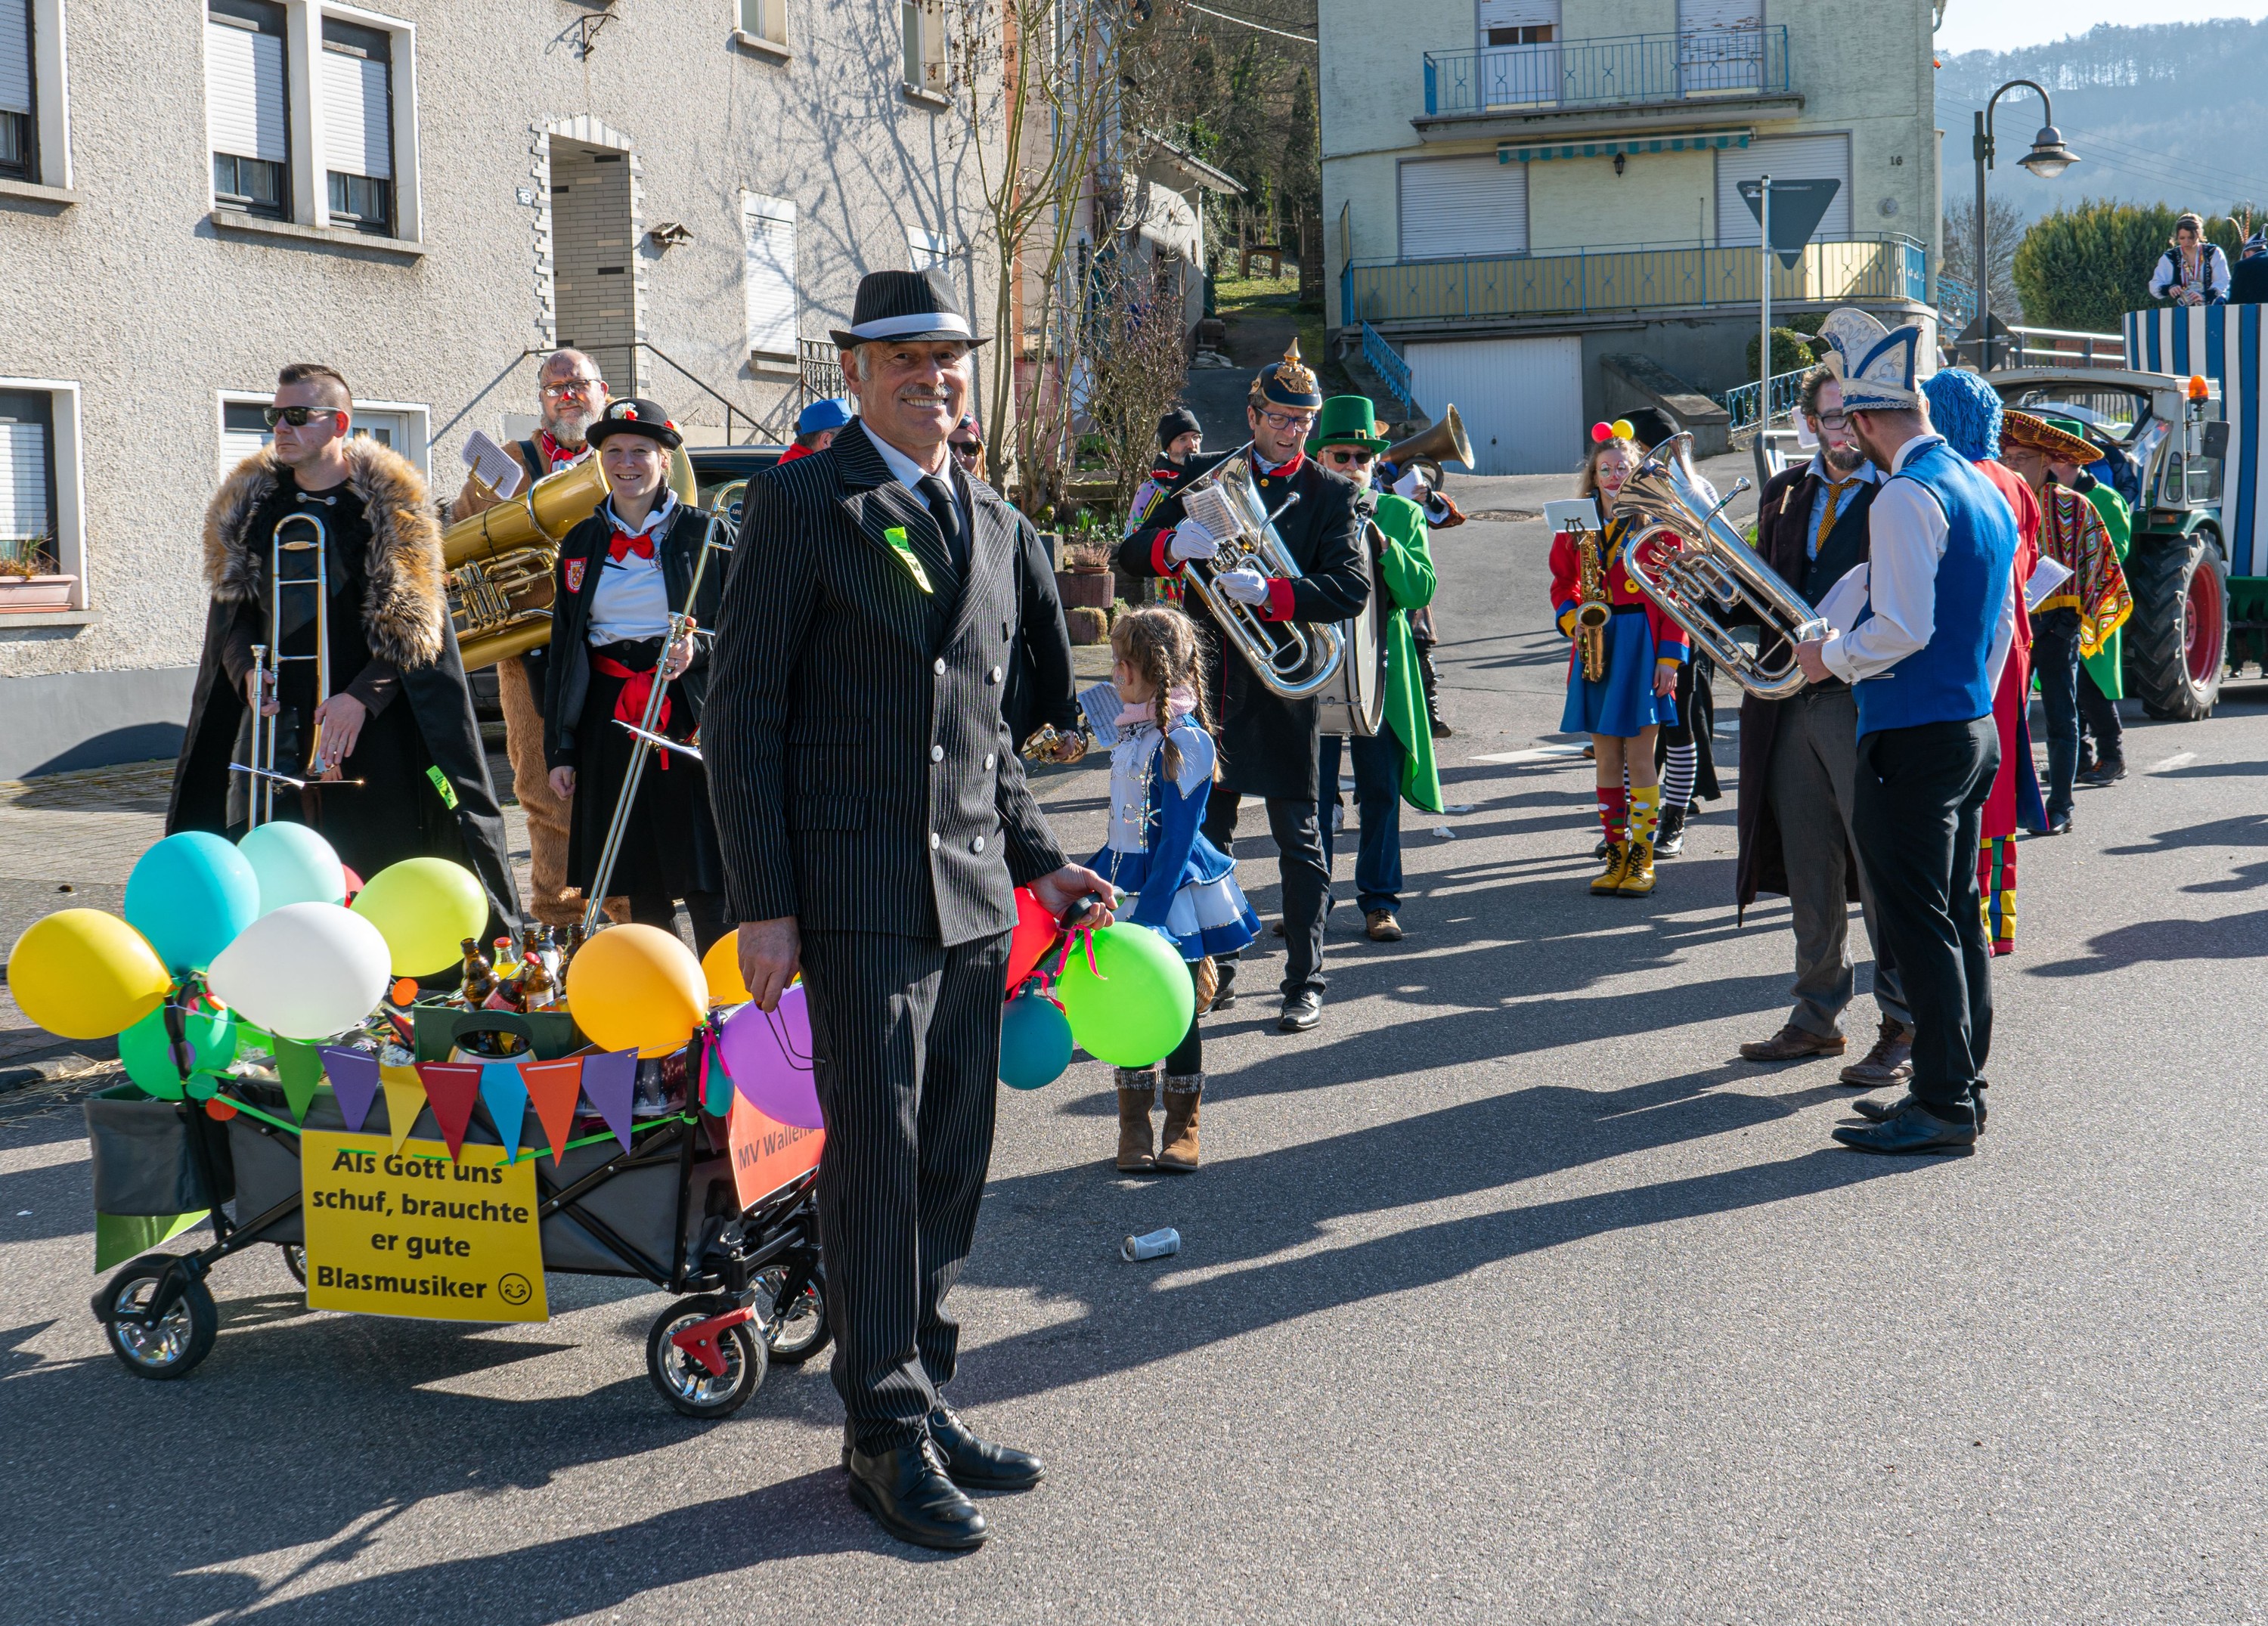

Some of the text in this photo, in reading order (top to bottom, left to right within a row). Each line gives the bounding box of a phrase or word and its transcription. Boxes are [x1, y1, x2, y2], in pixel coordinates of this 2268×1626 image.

[1890, 156, 1903, 166] 16
[518, 192, 531, 204] 19
[739, 1126, 814, 1170] MV Wallen
[331, 1151, 503, 1185] Als Gott uns
[312, 1188, 529, 1224] schuf, brauchte
[370, 1233, 471, 1260] er gute
[318, 1265, 488, 1299] Blasmusiker
